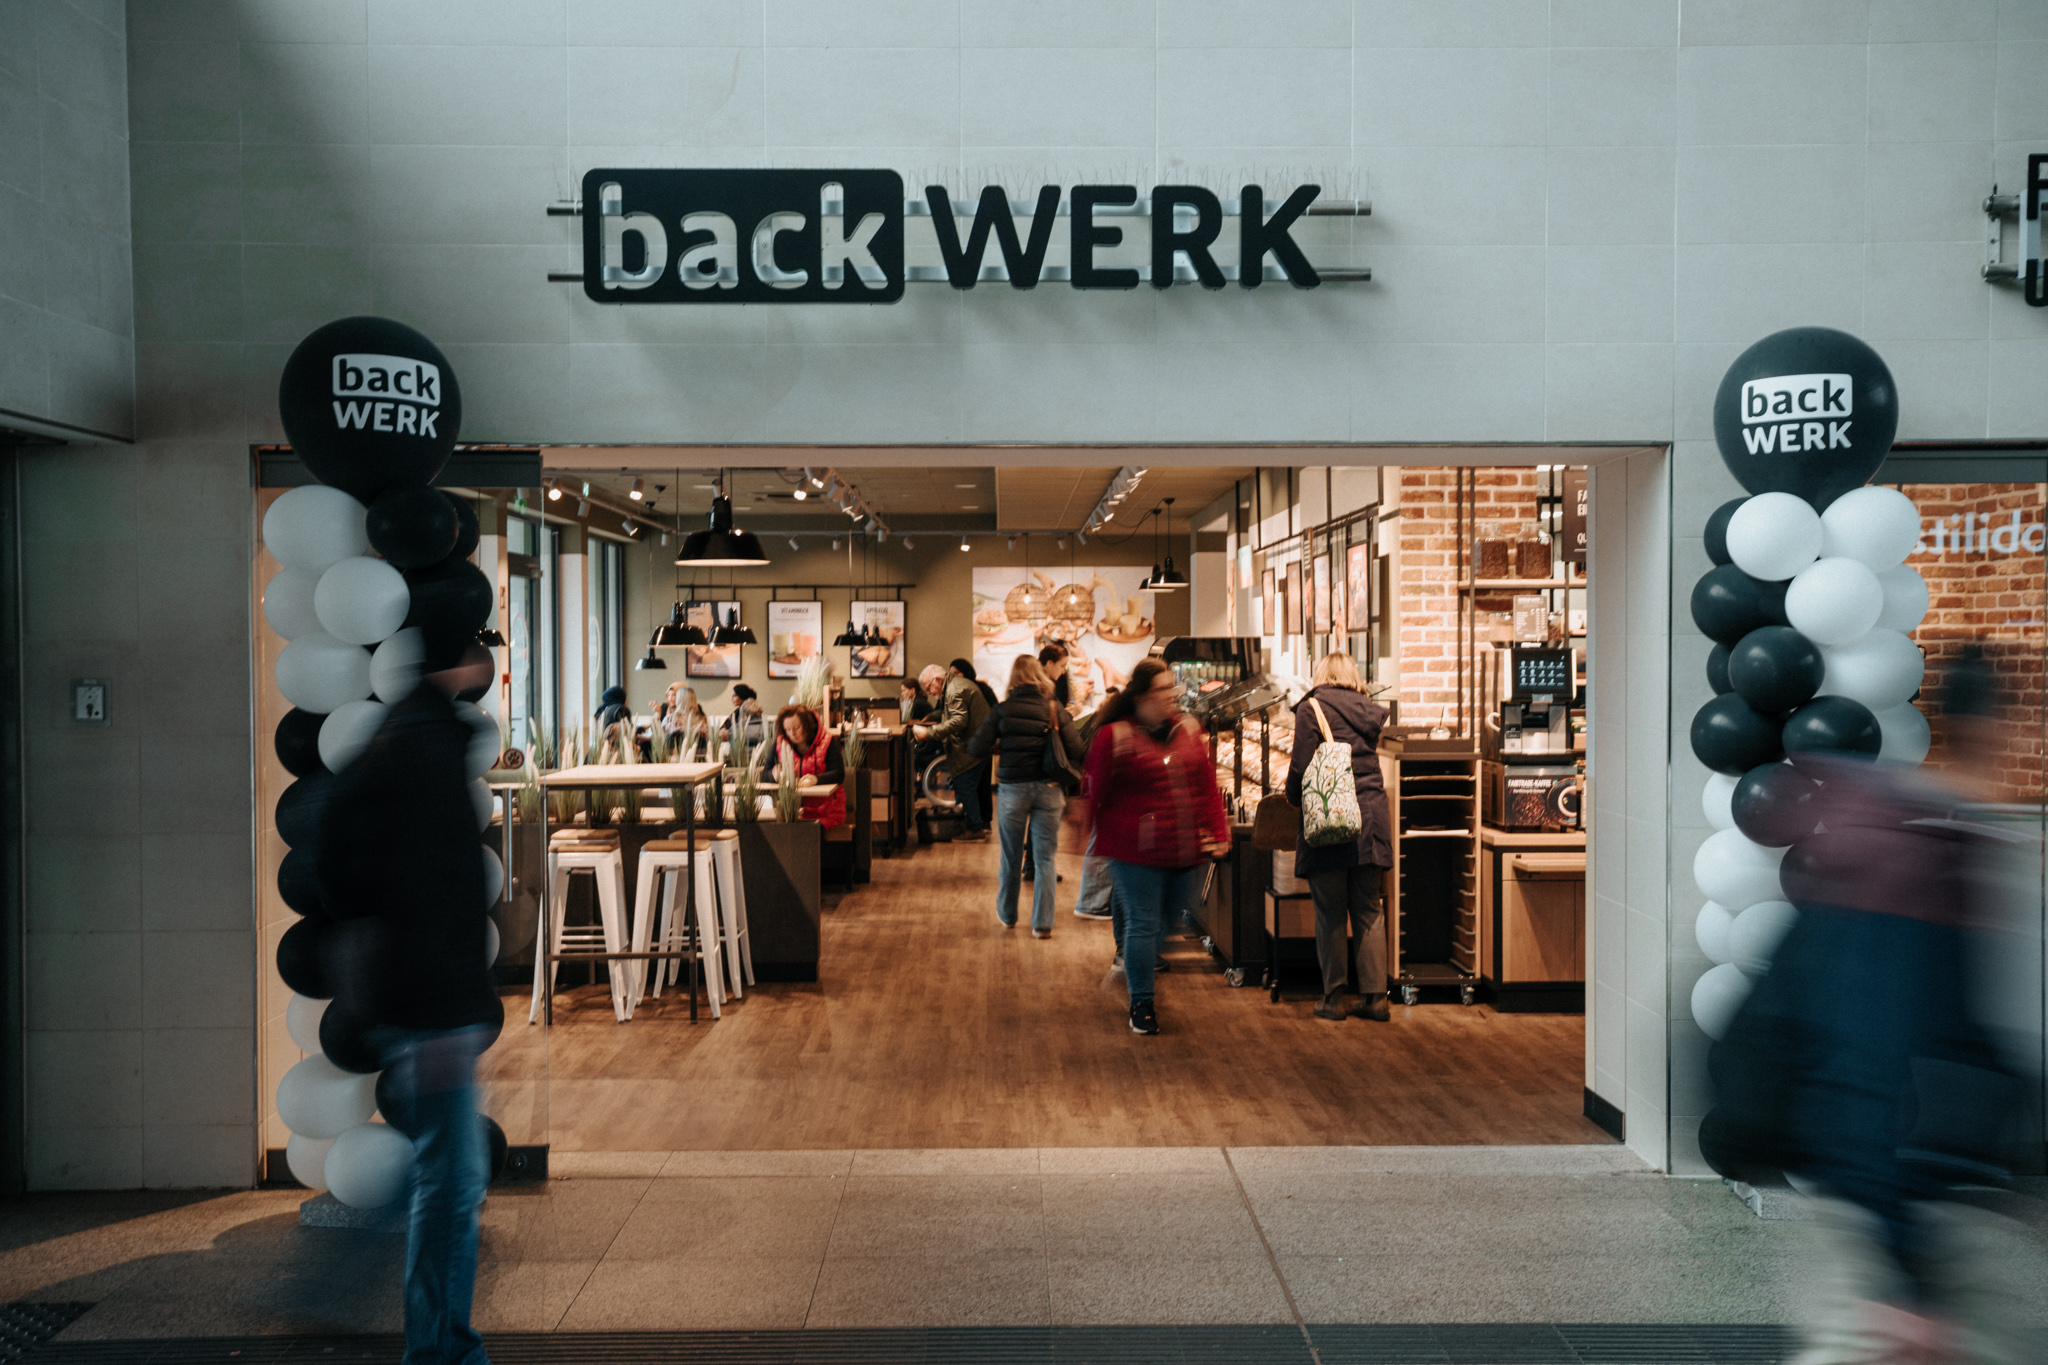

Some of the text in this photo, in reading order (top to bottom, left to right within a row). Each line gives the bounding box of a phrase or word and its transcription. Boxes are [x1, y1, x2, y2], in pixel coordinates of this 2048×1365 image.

[599, 181, 1322, 290] back WERK
[339, 358, 436, 400] back
[1748, 378, 1846, 418] back
[333, 401, 440, 439] WERK
[1742, 421, 1853, 455] WERK
